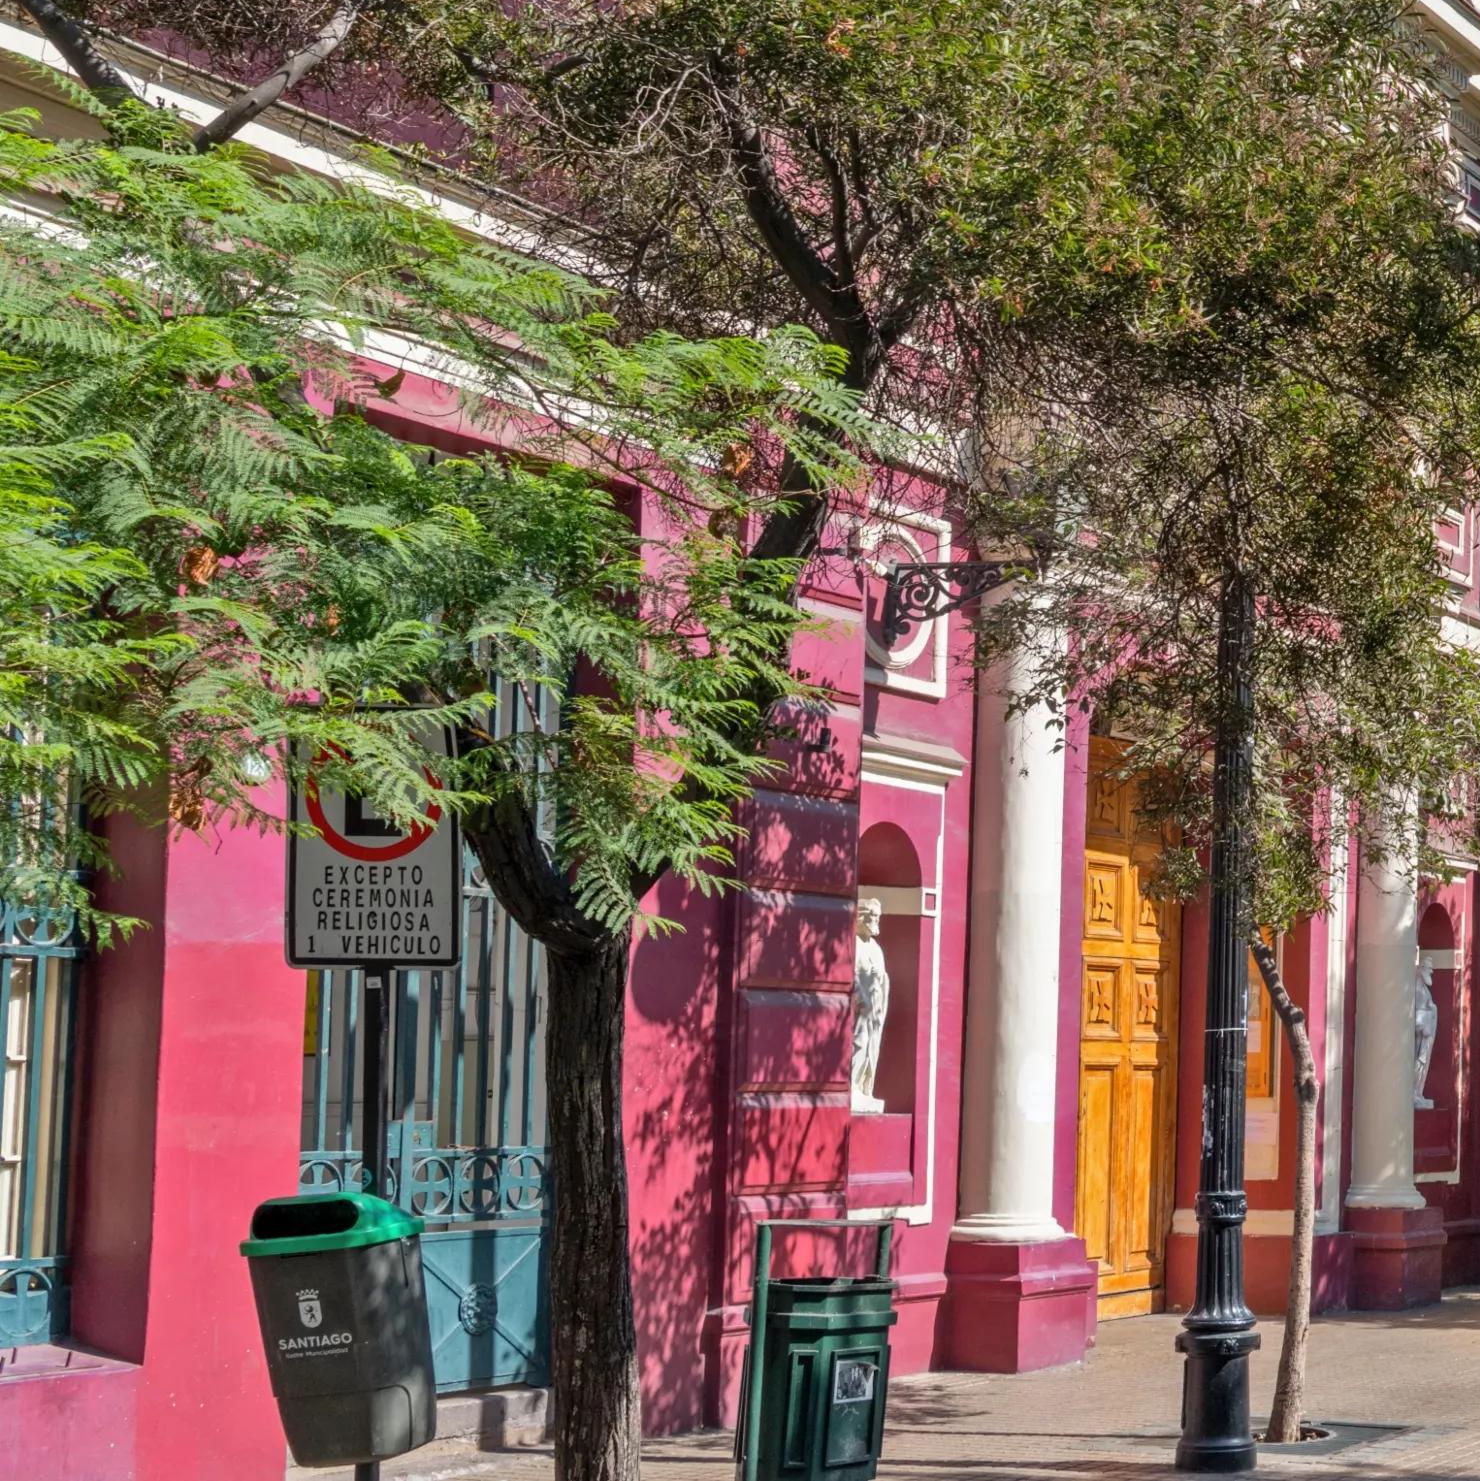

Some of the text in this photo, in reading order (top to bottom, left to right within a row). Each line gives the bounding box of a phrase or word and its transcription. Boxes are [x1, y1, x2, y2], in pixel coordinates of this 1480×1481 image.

[324, 864, 423, 886] EXCEPTO
[312, 887, 434, 909] CEREMONIA
[316, 910, 430, 932] RELIGIOSA
[307, 934, 441, 955] 1 VEHICULO
[278, 1332, 353, 1350] SANTIAGO
